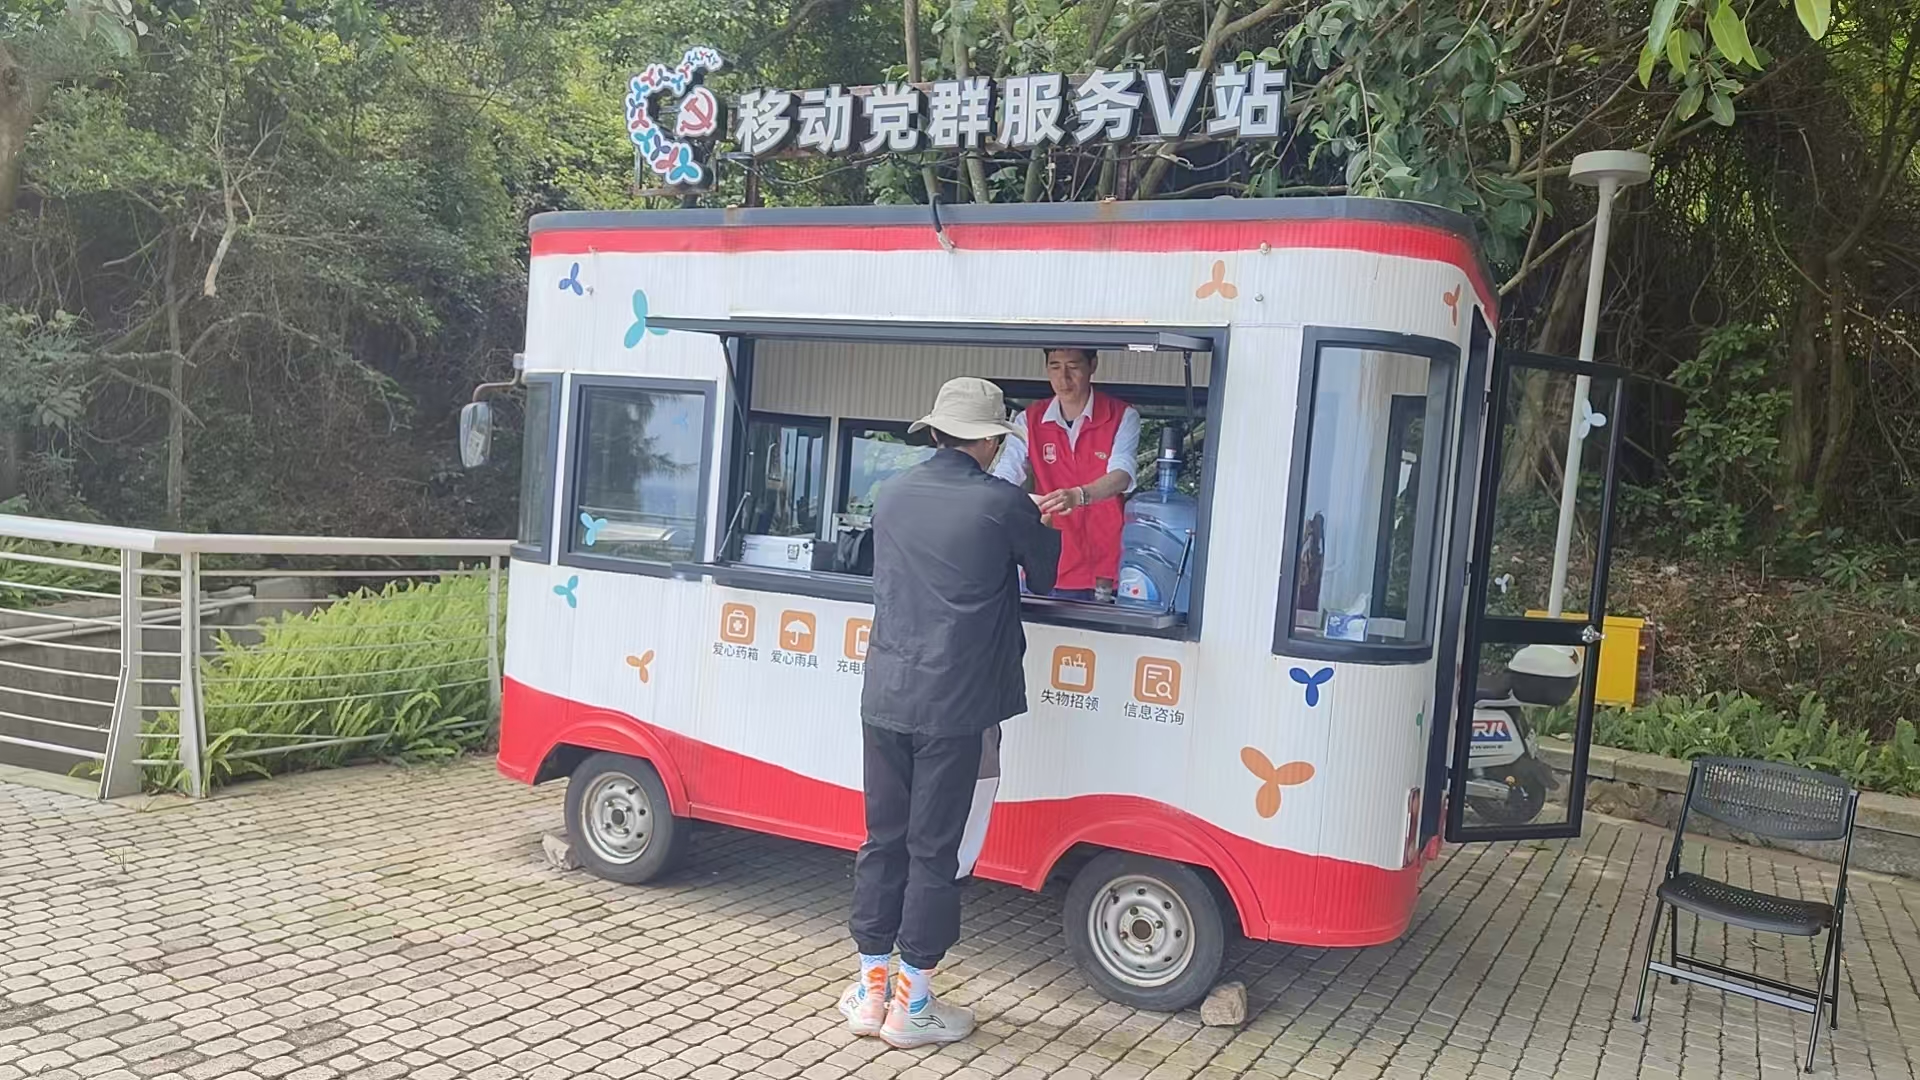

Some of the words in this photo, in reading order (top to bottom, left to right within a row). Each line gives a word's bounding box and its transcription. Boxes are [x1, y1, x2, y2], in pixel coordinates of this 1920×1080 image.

[735, 61, 1289, 154] 移动党群服务V站
[713, 642, 759, 662] 爱心药箱
[770, 650, 819, 669] 爱心雨具
[1040, 689, 1100, 712] 失物招领
[1123, 702, 1185, 726] 信息咨询
